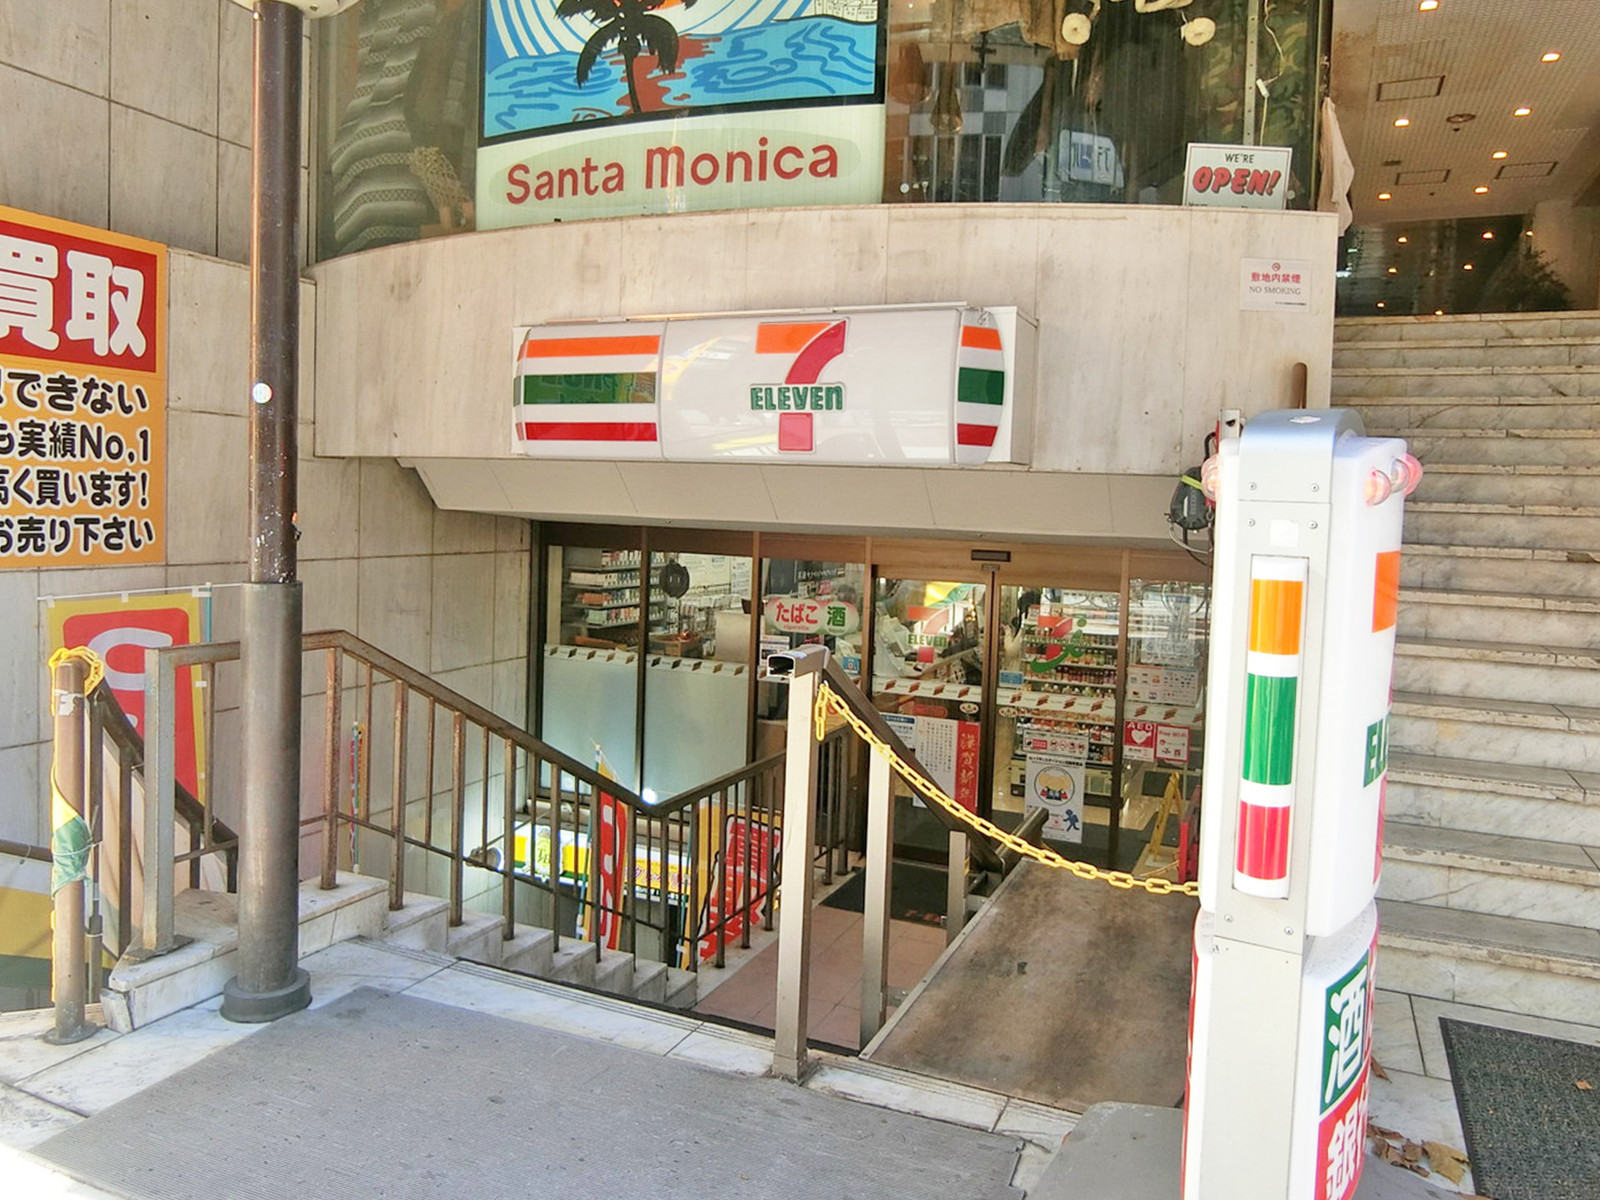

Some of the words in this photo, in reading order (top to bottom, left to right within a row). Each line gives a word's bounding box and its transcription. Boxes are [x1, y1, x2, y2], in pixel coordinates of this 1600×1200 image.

[1225, 153, 1255, 163] WE'RE
[506, 157, 625, 205] Santa
[1193, 166, 1281, 196] OPEN!
[1249, 285, 1262, 294] NO
[1264, 286, 1301, 296] SMOKING
[0, 369, 147, 415] できない
[776, 603, 818, 625] たばこ
[827, 605, 846, 627] 酒
[1127, 722, 1153, 731] AED
[1325, 965, 1368, 1103] 酒
